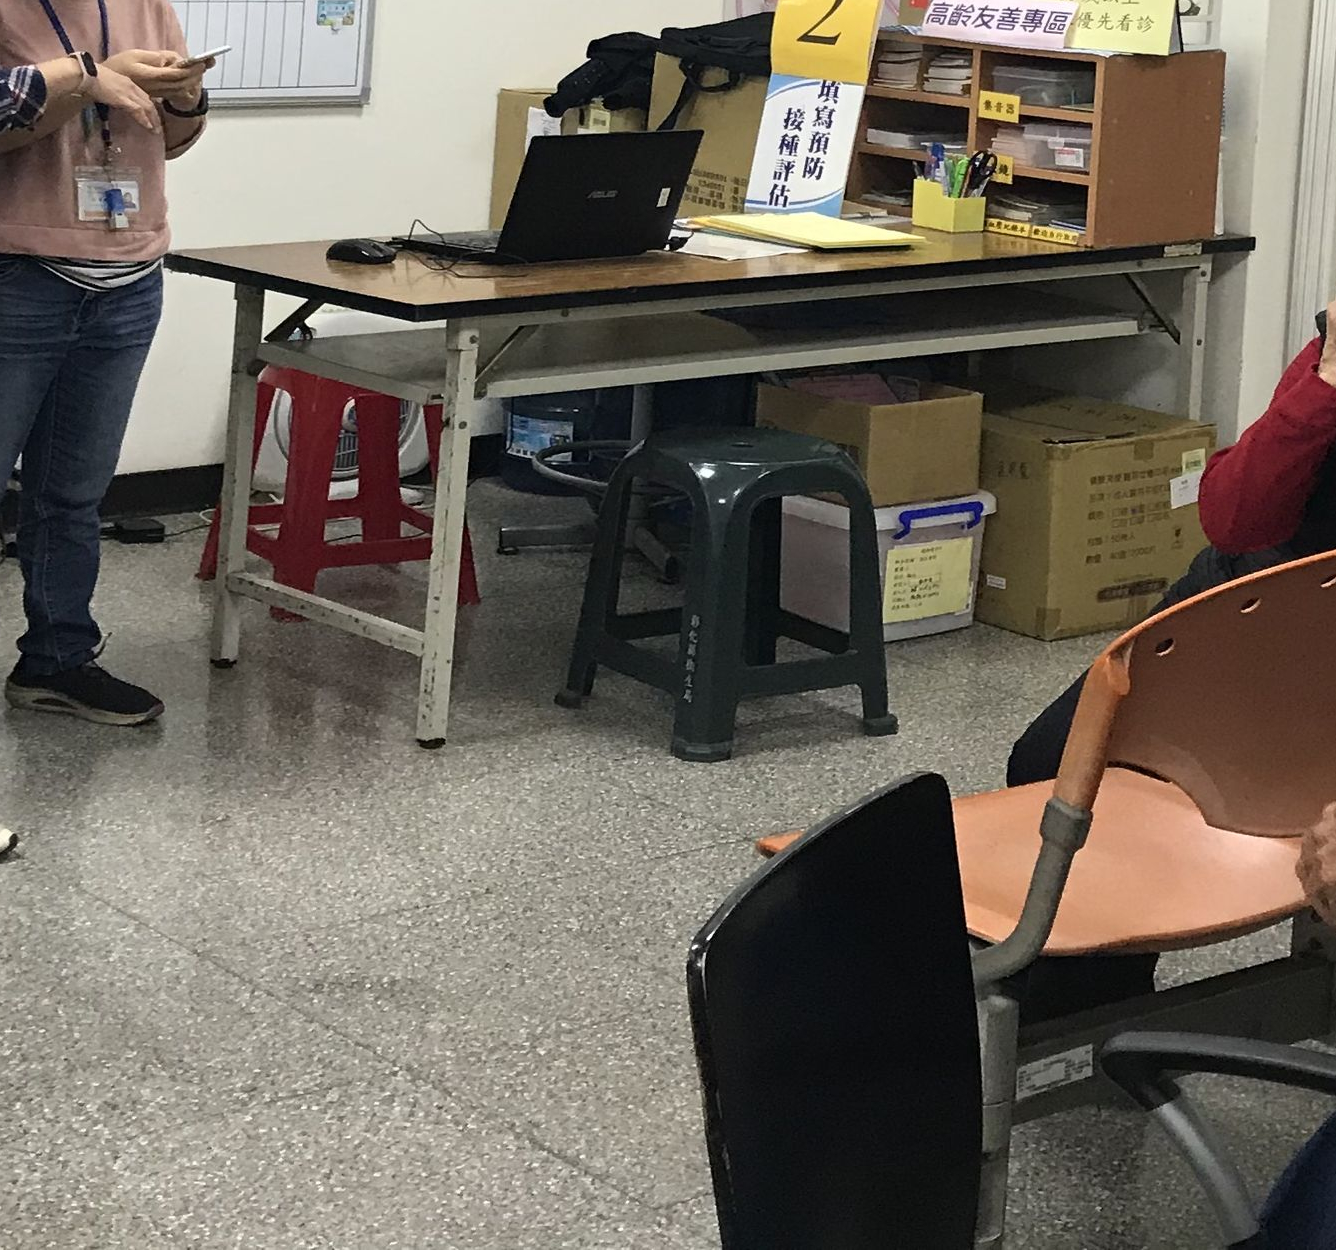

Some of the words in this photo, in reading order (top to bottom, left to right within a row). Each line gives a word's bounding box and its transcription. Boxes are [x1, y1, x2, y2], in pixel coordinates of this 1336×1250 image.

[926, 1, 1073, 35] 高齡友善專區
[1070, 12, 1155, 33] 優先看診
[768, 107, 805, 208] 接種評估
[803, 80, 841, 180] 填寫預防
